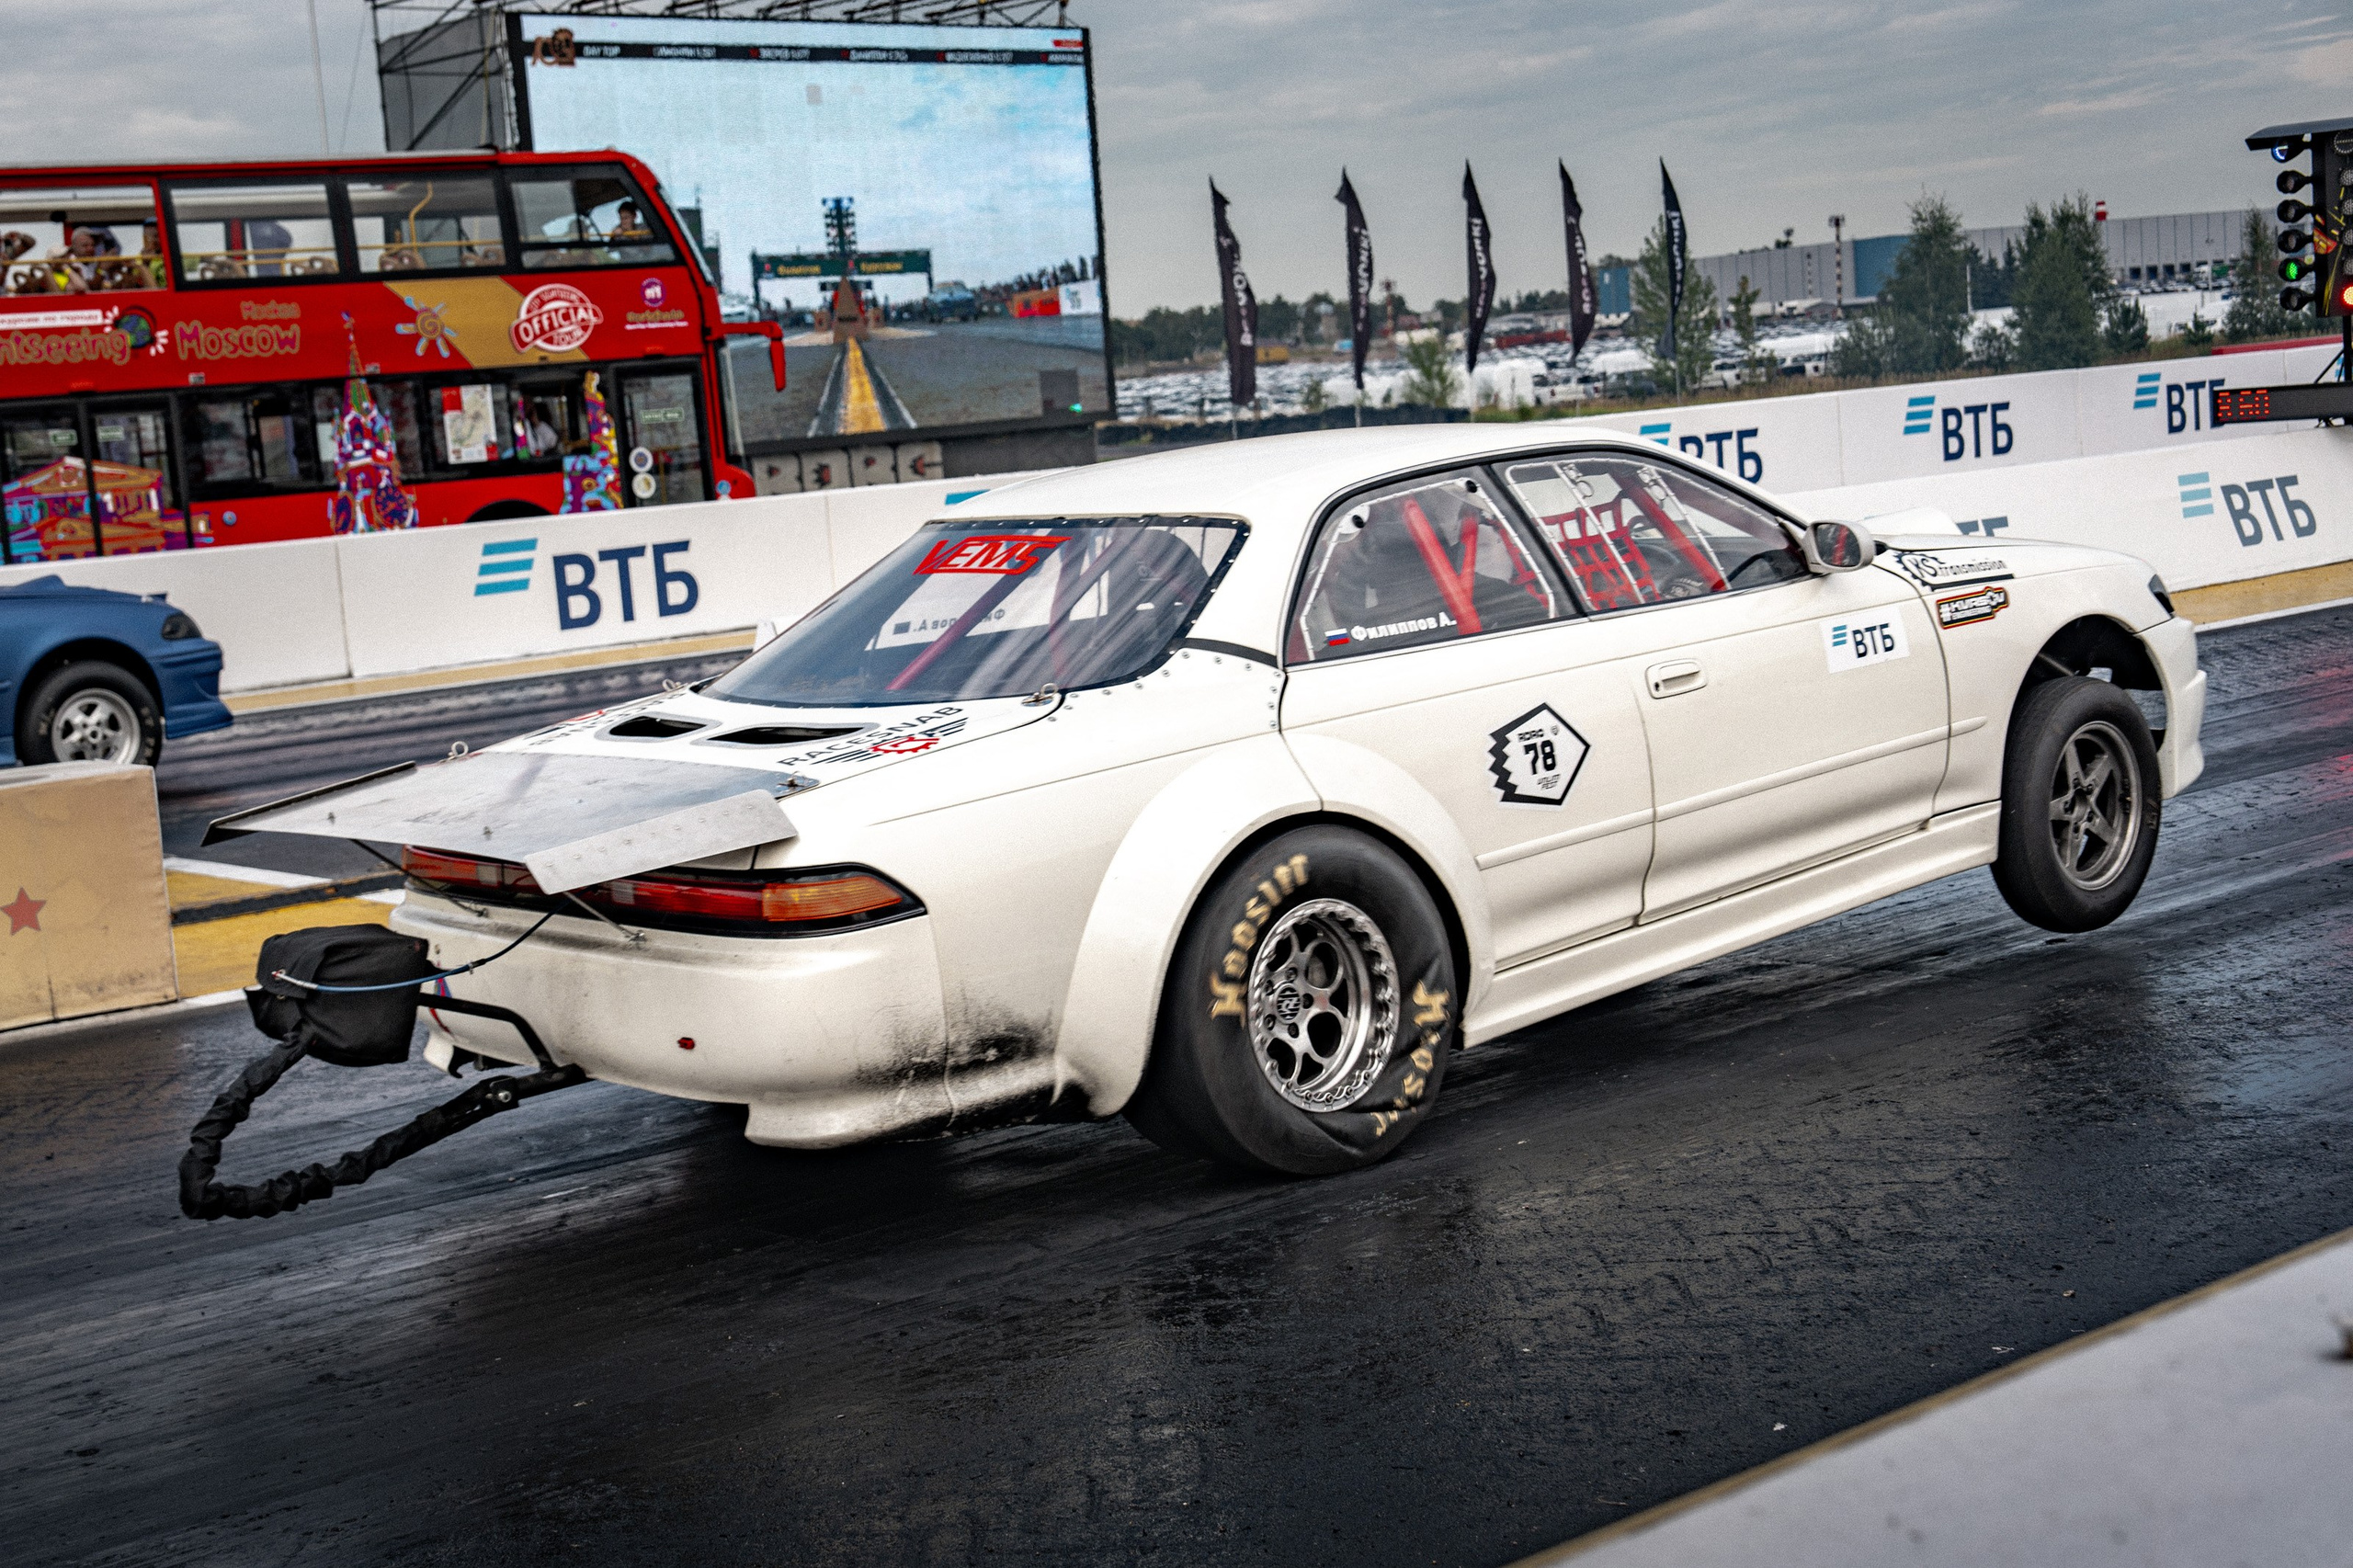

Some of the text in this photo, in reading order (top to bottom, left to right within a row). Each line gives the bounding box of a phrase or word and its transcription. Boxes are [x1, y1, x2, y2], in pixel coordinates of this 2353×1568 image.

[518, 305, 598, 343] OFFICIAL
[2165, 378, 2225, 434] ВТБ
[1941, 402, 2014, 461] ВТБ
[2220, 474, 2317, 547] ВТБ
[912, 534, 1074, 575] VEMS
[552, 540, 699, 631] ВТБ
[1350, 617, 1438, 641] Филиппов
[1852, 622, 1895, 658] ВТБ
[777, 706, 964, 767] RACESNAB
[1523, 739, 1557, 775] 78
